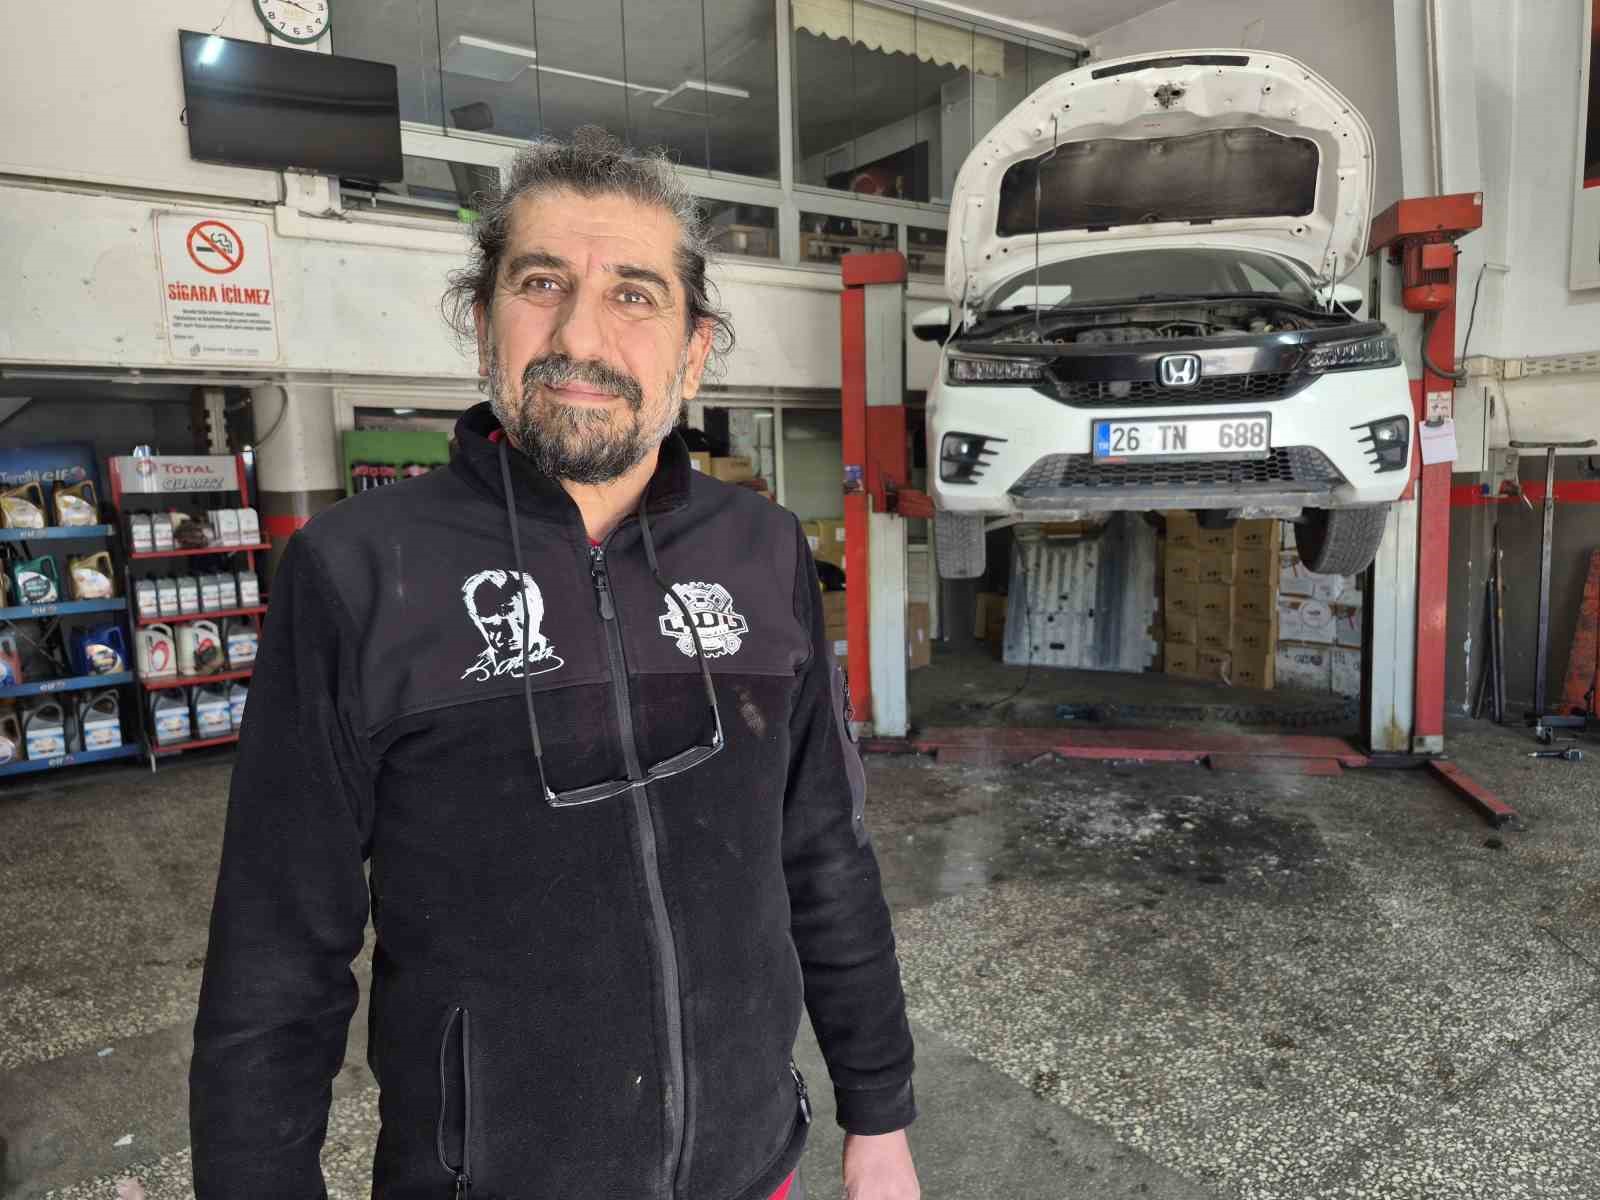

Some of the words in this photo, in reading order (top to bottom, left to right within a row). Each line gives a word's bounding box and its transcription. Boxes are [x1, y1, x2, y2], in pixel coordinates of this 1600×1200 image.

[168, 281, 218, 303] SİGARA
[221, 283, 272, 306] İÇİLMEZ
[1112, 427, 1140, 451] 26
[1158, 424, 1188, 450] TN
[1219, 422, 1264, 449] 688
[161, 463, 215, 474] TOTAL
